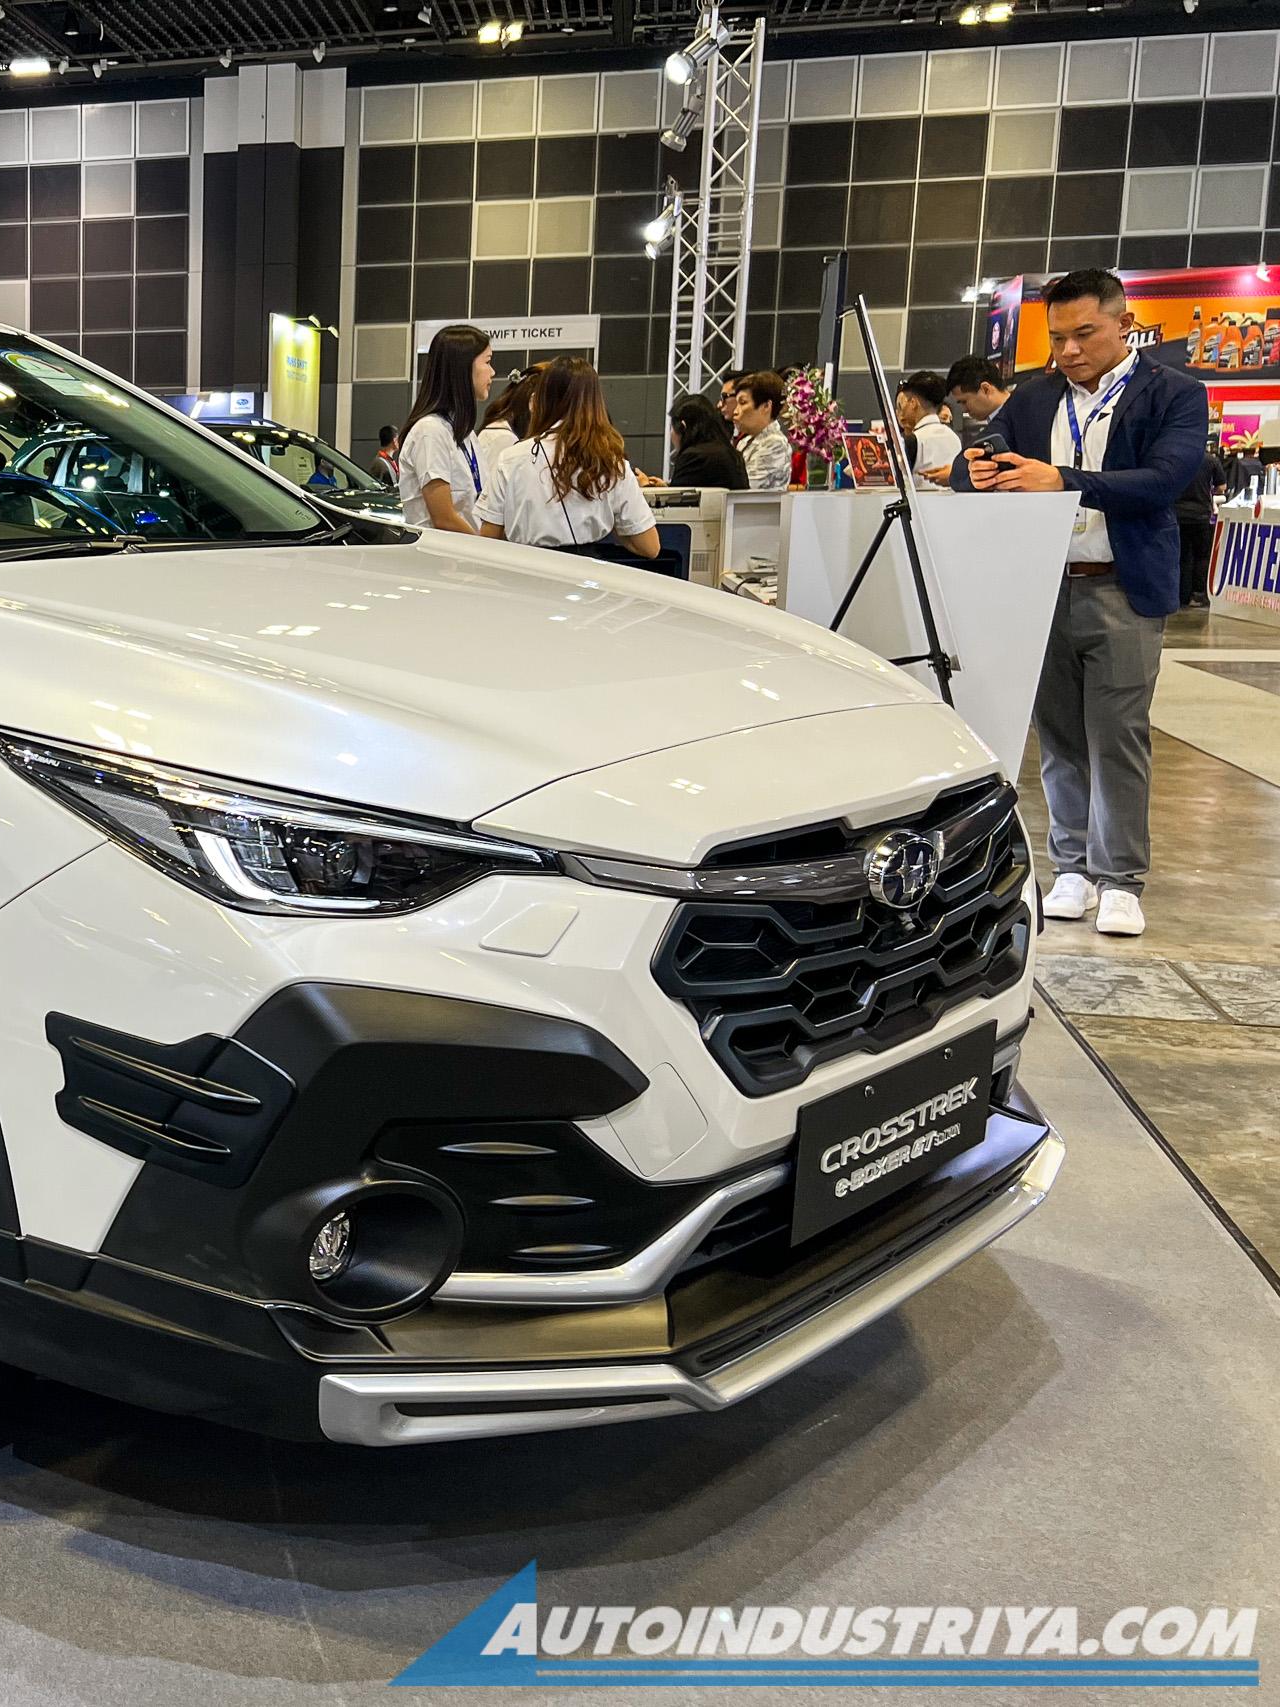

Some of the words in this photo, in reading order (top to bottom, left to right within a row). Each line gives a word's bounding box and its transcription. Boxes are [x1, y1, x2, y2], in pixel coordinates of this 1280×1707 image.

[521, 327, 563, 338] TICKET
[1125, 328, 1157, 350] ALL
[820, 1076, 979, 1174] CROSSTREK
[834, 1144, 911, 1198] e-BOXER
[910, 1130, 938, 1159] GT
